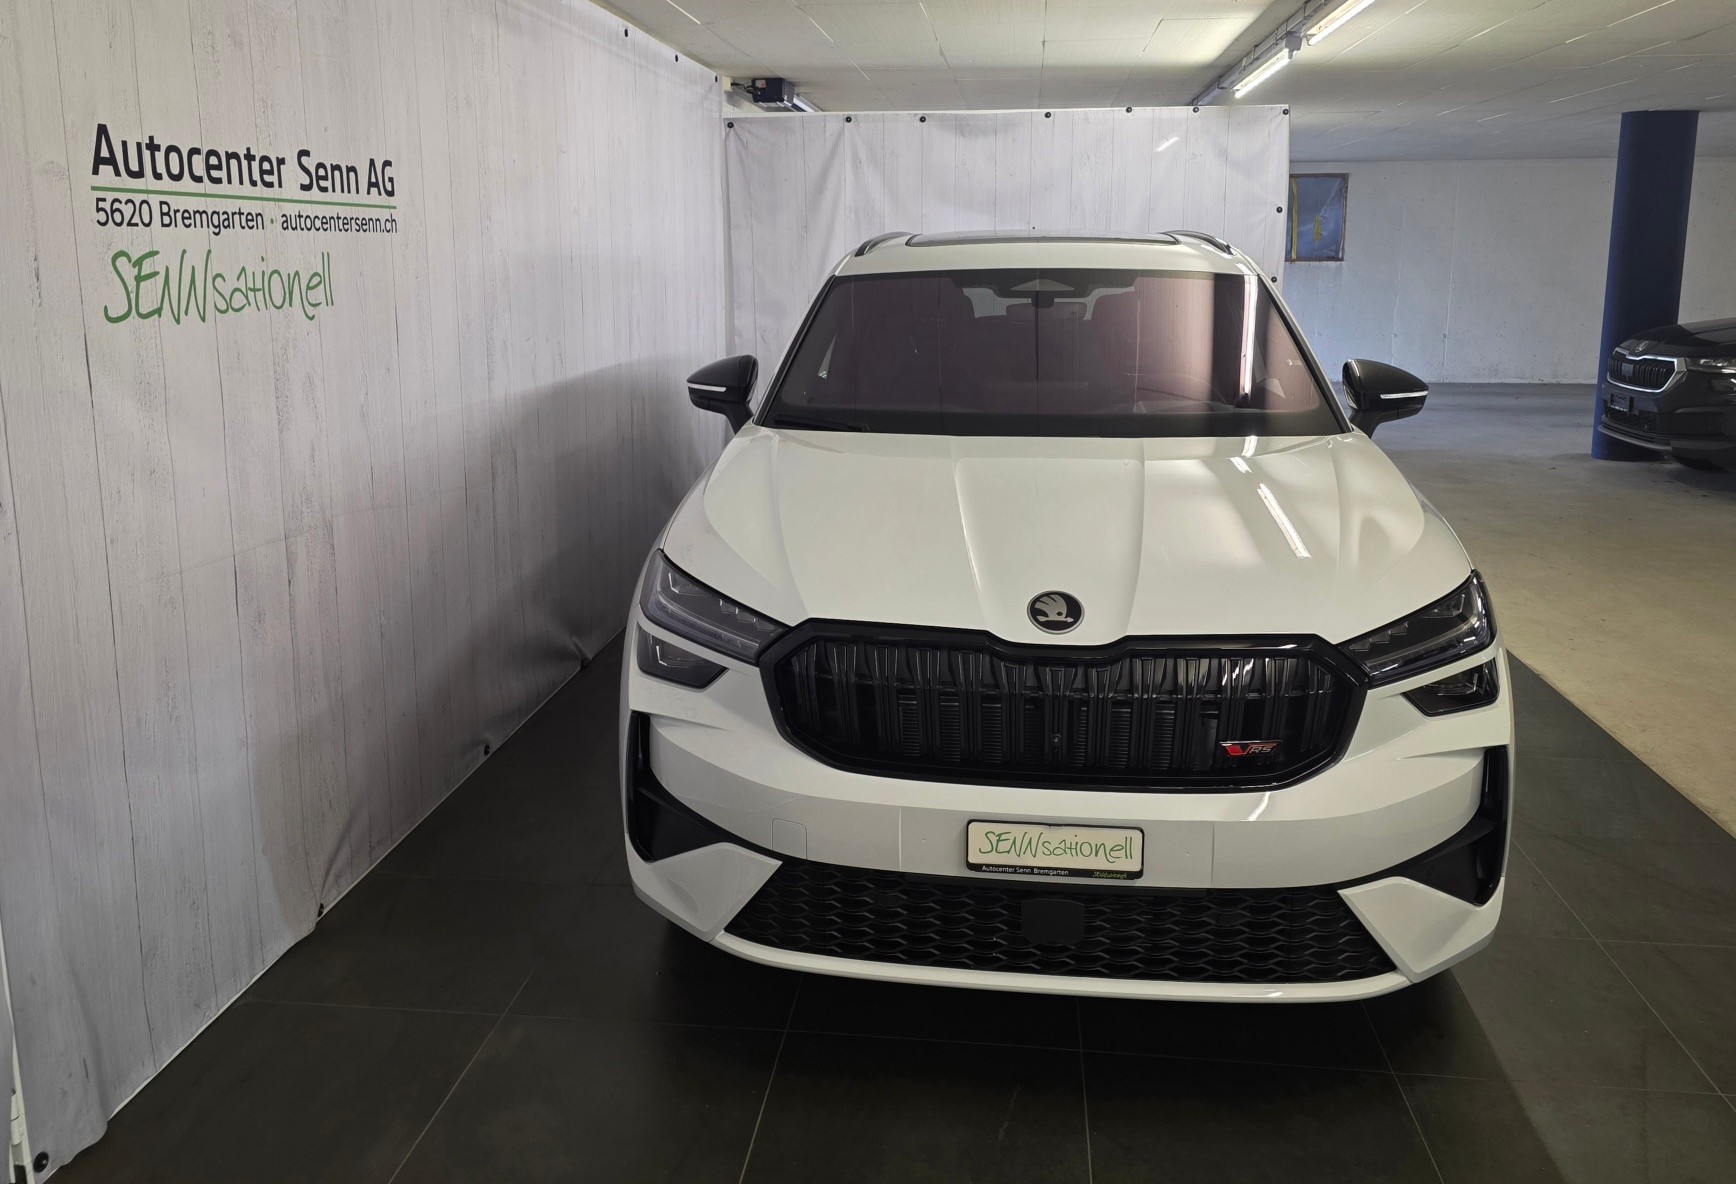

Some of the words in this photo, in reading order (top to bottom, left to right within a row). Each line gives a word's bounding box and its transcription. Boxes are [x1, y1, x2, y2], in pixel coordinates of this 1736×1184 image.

[91, 123, 286, 189] Autocenter
[296, 149, 360, 194] Senn
[366, 158, 396, 197] AG
[95, 197, 153, 228] 5620
[159, 201, 265, 236] Bremgarten
[280, 212, 398, 234] autocentersenn.ch
[103, 248, 334, 326] SENNsationell
[978, 831, 1134, 864] SENNsationell
[981, 865, 1015, 873] Autocenter
[1033, 868, 1069, 876] Bremgarten
